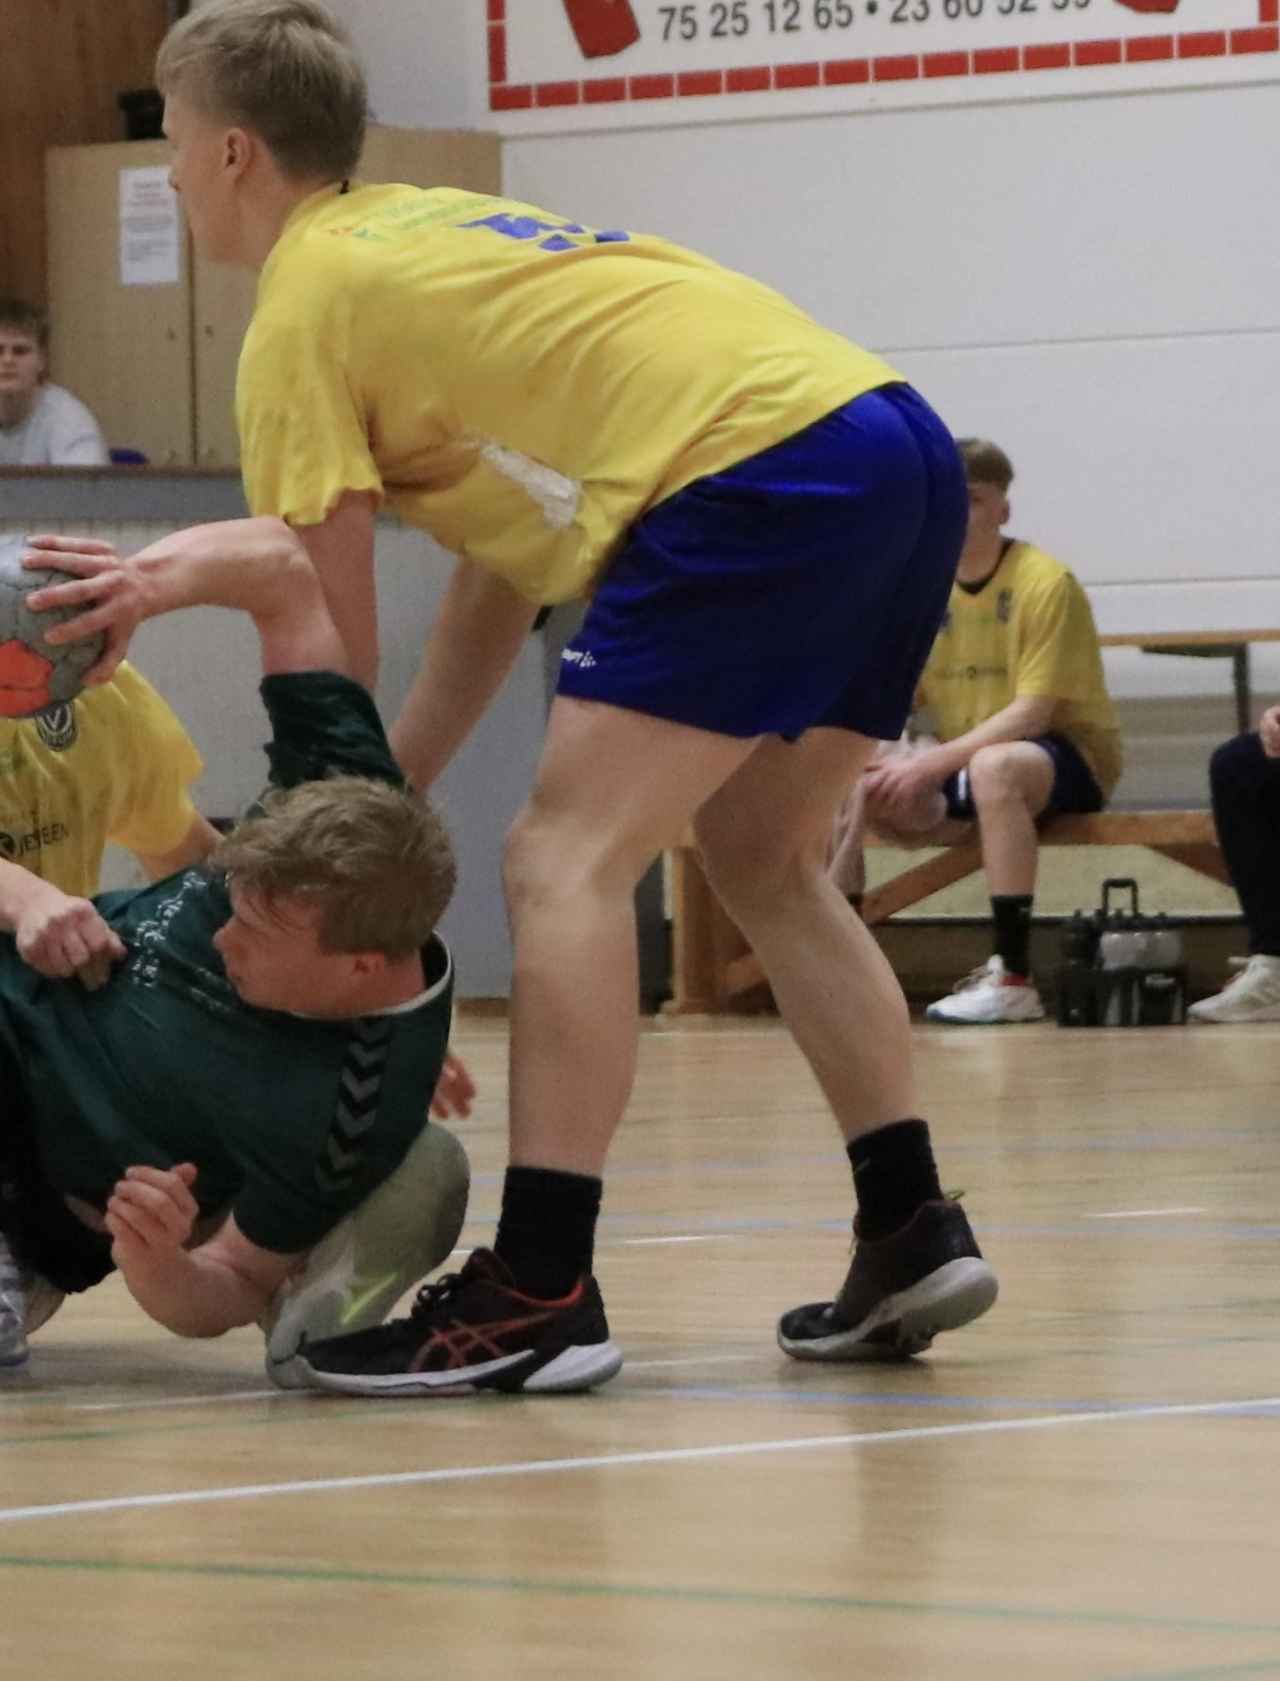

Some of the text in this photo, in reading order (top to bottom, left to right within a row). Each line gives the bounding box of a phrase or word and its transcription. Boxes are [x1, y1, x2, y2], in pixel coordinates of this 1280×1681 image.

[658, 6, 698, 41] 75
[710, 1, 749, 37] 25
[764, 0, 801, 33] 12
[813, 0, 853, 30] 65
